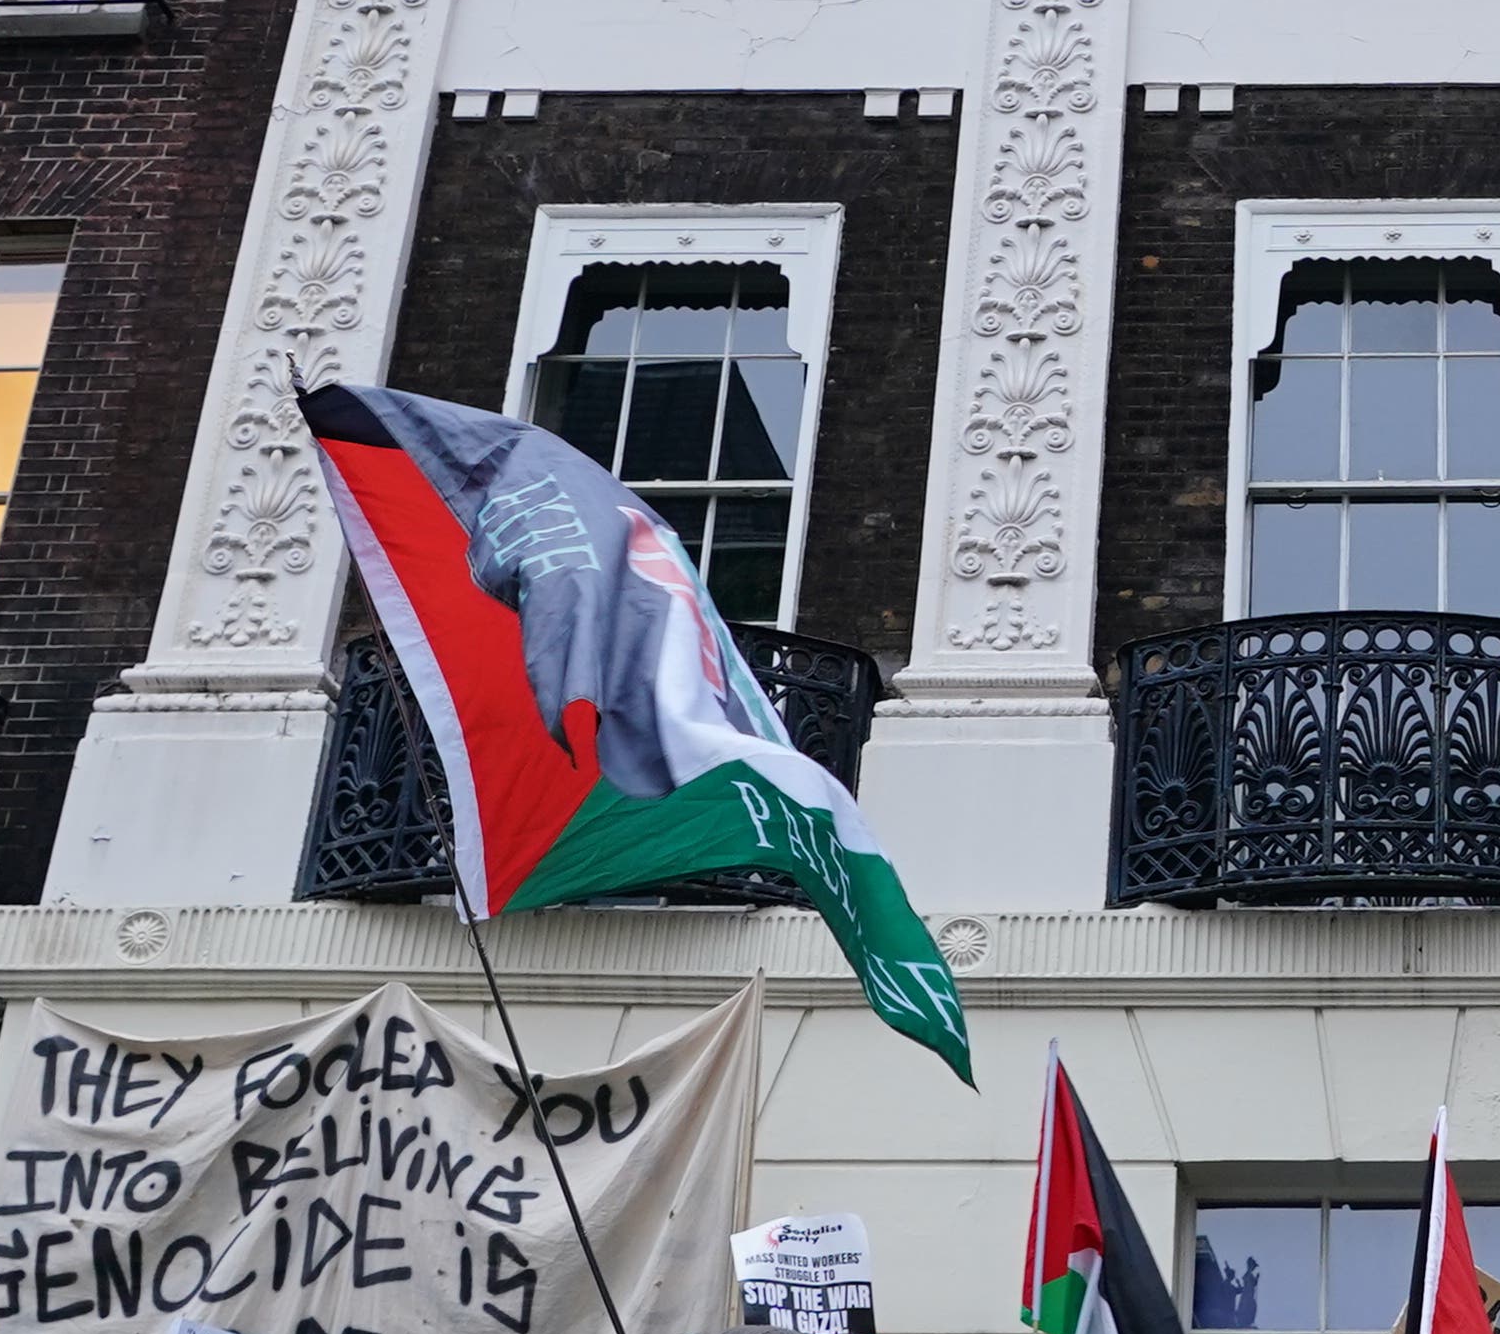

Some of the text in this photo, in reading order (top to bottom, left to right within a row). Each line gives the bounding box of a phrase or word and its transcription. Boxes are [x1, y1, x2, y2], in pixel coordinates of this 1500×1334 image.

[33, 1014, 650, 1146] THEY FOOLED YOU
[782, 1224, 843, 1236] Socialist
[778, 1234, 819, 1245] Party
[745, 1253, 774, 1265] MASS
[778, 1253, 809, 1267] UNITED
[775, 1267, 835, 1283] STRUGGLE TO
[743, 1282, 871, 1310] STOP THE WAR
[770, 1307, 793, 1331] ON
